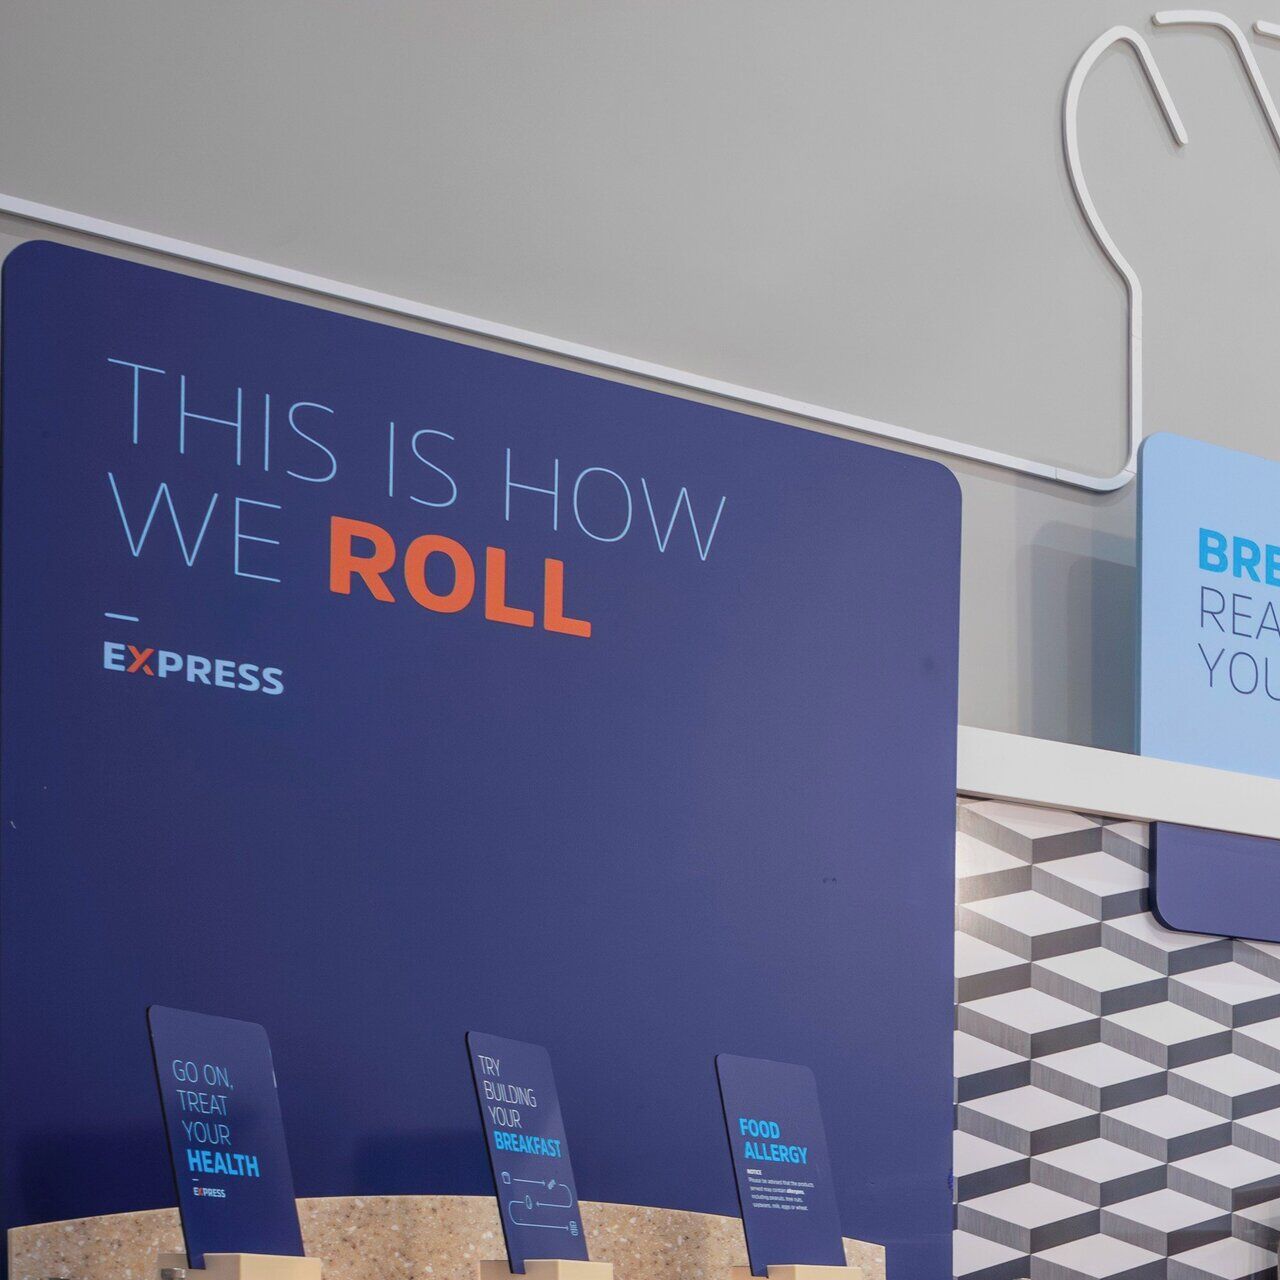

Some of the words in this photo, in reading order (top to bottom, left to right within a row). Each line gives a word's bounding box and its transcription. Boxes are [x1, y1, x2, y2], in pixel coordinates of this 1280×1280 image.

[107, 357, 338, 483] THIS
[388, 420, 458, 508] IS
[505, 447, 727, 561] HOW
[108, 471, 283, 583] WE
[329, 515, 592, 638] ROLL
[103, 640, 285, 696] EXPRESS
[172, 1059, 198, 1082] GO
[478, 1055, 500, 1077] TRY
[176, 1089, 228, 1116] TREAT
[483, 1080, 537, 1108] BUILDING
[488, 1106, 522, 1129] YOUR
[739, 1118, 781, 1140] FOOD
[181, 1120, 231, 1146] YOUR
[493, 1131, 561, 1158] BREAKFAST
[187, 1149, 260, 1178] HEALTH
[744, 1142, 808, 1165] ALLERGY
[193, 1187, 226, 1198] EXPRESS
